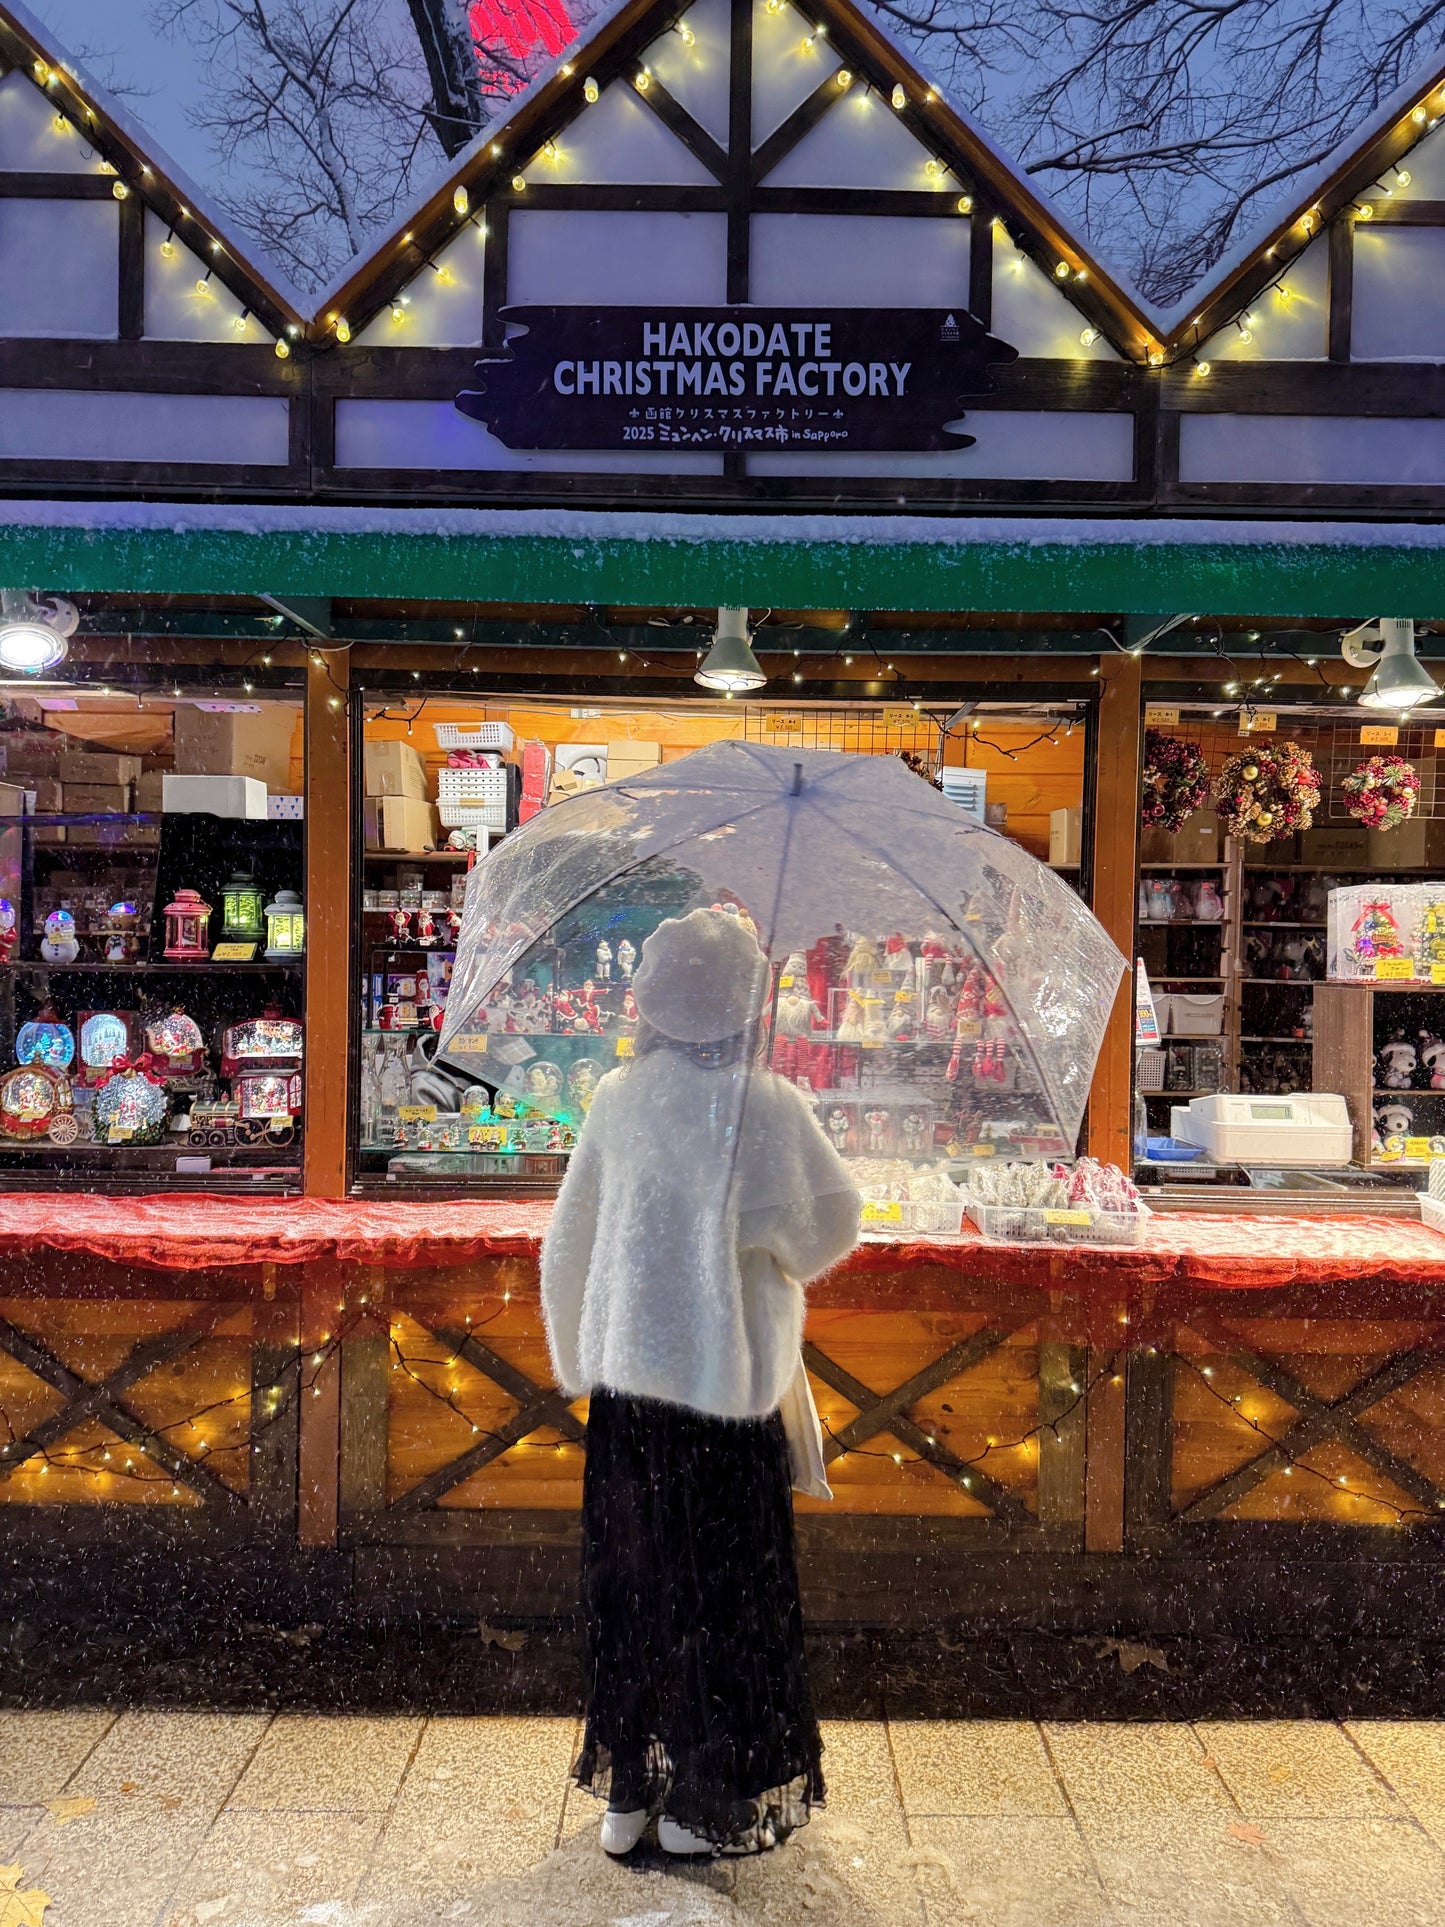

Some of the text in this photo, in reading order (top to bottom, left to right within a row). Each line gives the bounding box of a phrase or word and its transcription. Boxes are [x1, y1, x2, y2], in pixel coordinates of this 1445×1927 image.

[643, 321, 831, 357] HAKODATE
[553, 360, 912, 397] CHRISTMAS FACTORY
[645, 407, 829, 420] 函館クリスマスファクトリー
[622, 426, 655, 440] 2025
[791, 430, 801, 440] in
[802, 428, 848, 442] Sapporo
